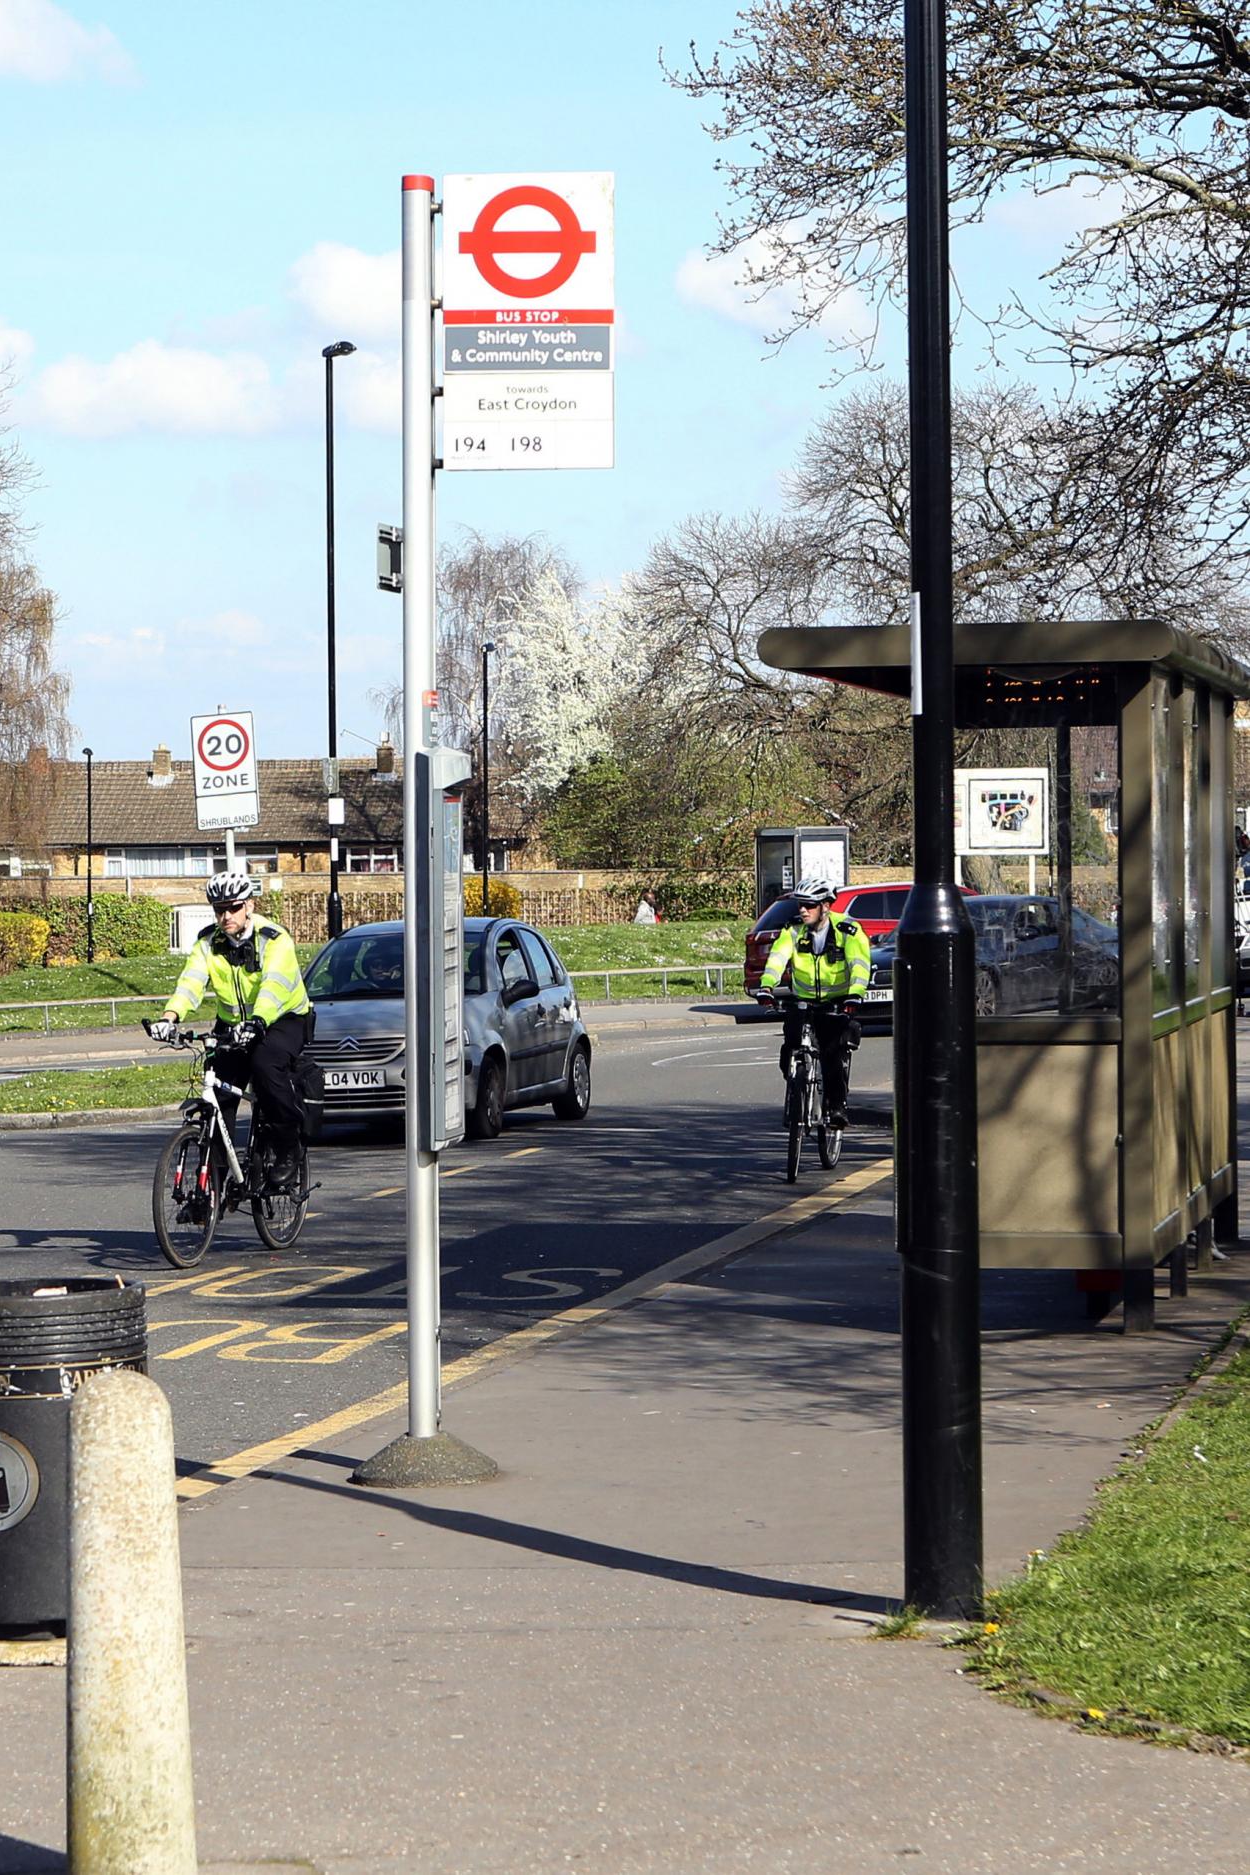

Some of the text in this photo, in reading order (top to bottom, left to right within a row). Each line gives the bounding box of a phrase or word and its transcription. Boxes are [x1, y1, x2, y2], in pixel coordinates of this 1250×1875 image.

[496, 311, 559, 322] BUS STOP
[477, 330, 576, 347] Shirley Youth
[451, 348, 603, 364] & Community Centre
[506, 385, 549, 394] towards
[478, 398, 577, 413] East Croydon
[455, 436, 542, 452] 194 198
[207, 733, 242, 756] 20
[202, 773, 249, 789] ZONE
[200, 813, 256, 828] SHRUBLANDS
[871, 991, 888, 1000] DPH
[353, 1072, 379, 1085] VOK
